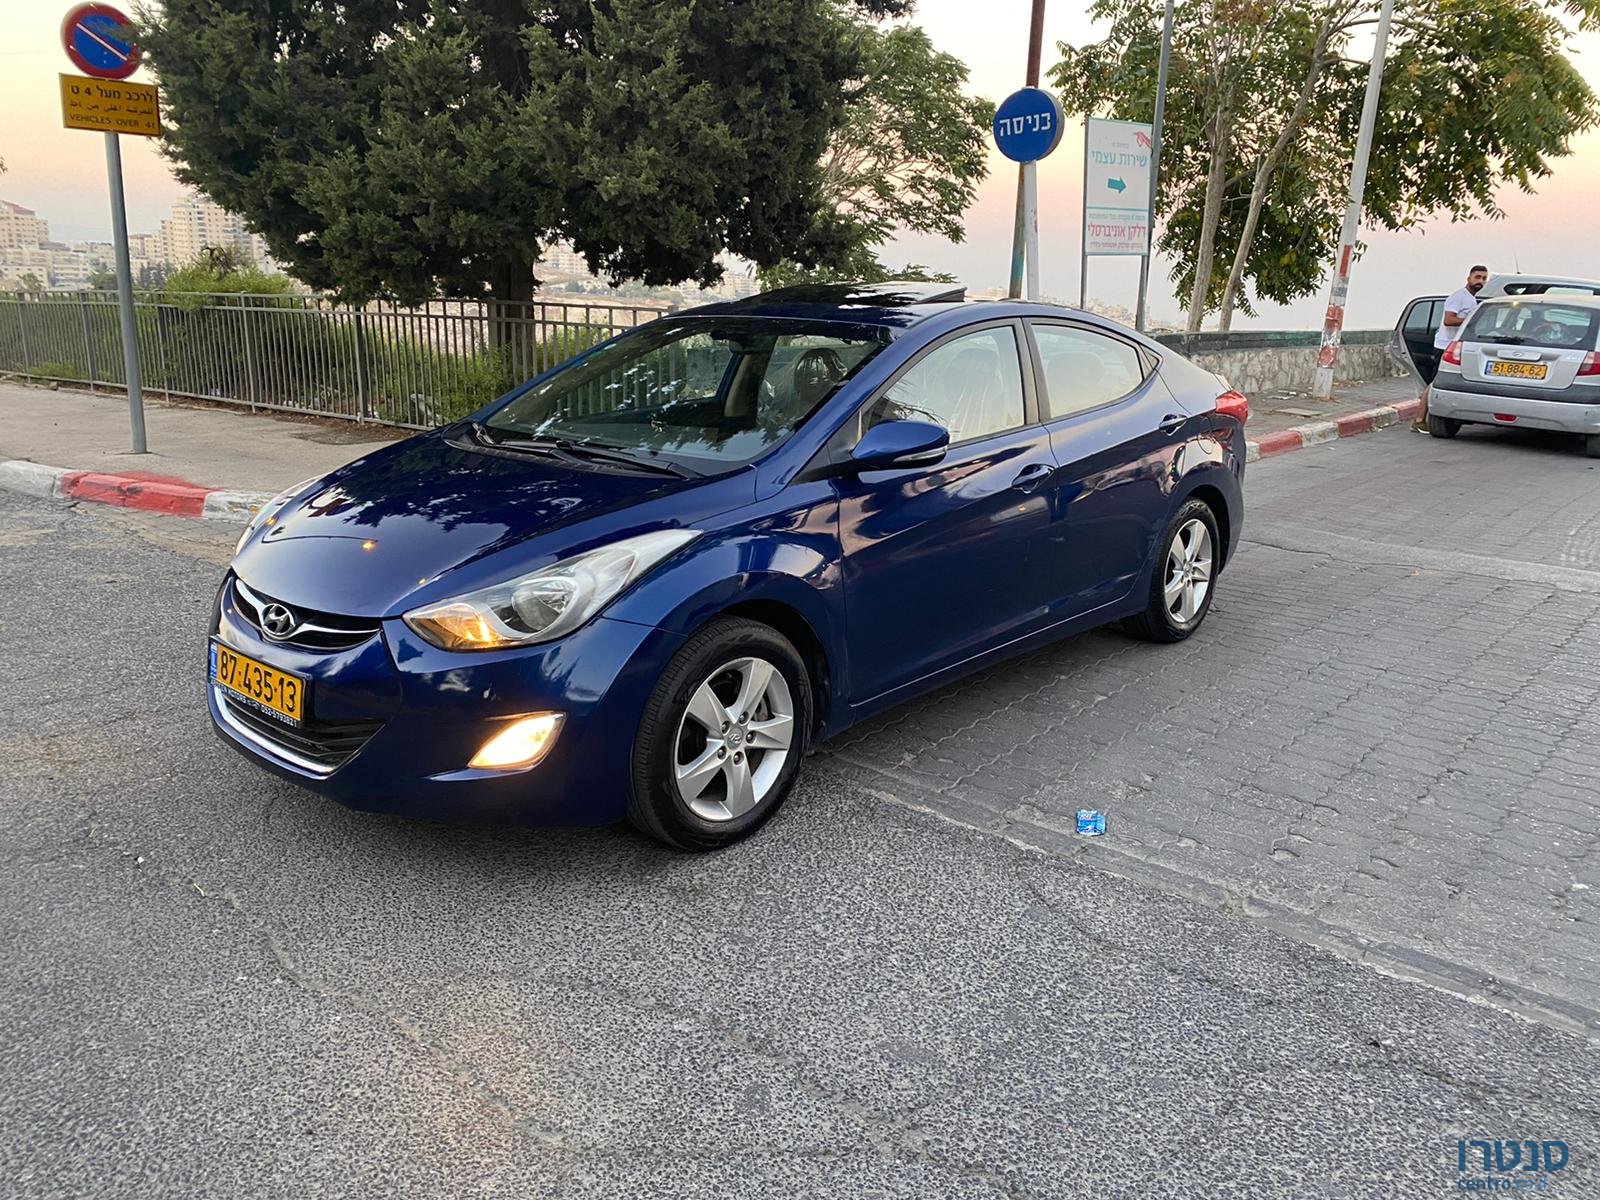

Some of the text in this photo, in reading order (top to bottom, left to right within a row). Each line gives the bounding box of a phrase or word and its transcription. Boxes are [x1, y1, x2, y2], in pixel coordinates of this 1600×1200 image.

[84, 87, 92, 96] 4
[96, 84, 121, 99] מעל
[125, 90, 153, 102] לרכב
[70, 113, 112, 125] VEHICLES
[116, 118, 139, 127] OVER
[1000, 112, 1051, 137] כניסה
[1091, 150, 1148, 168] שירות עצמי
[1087, 221, 1147, 241] דלקן אוניברסלי
